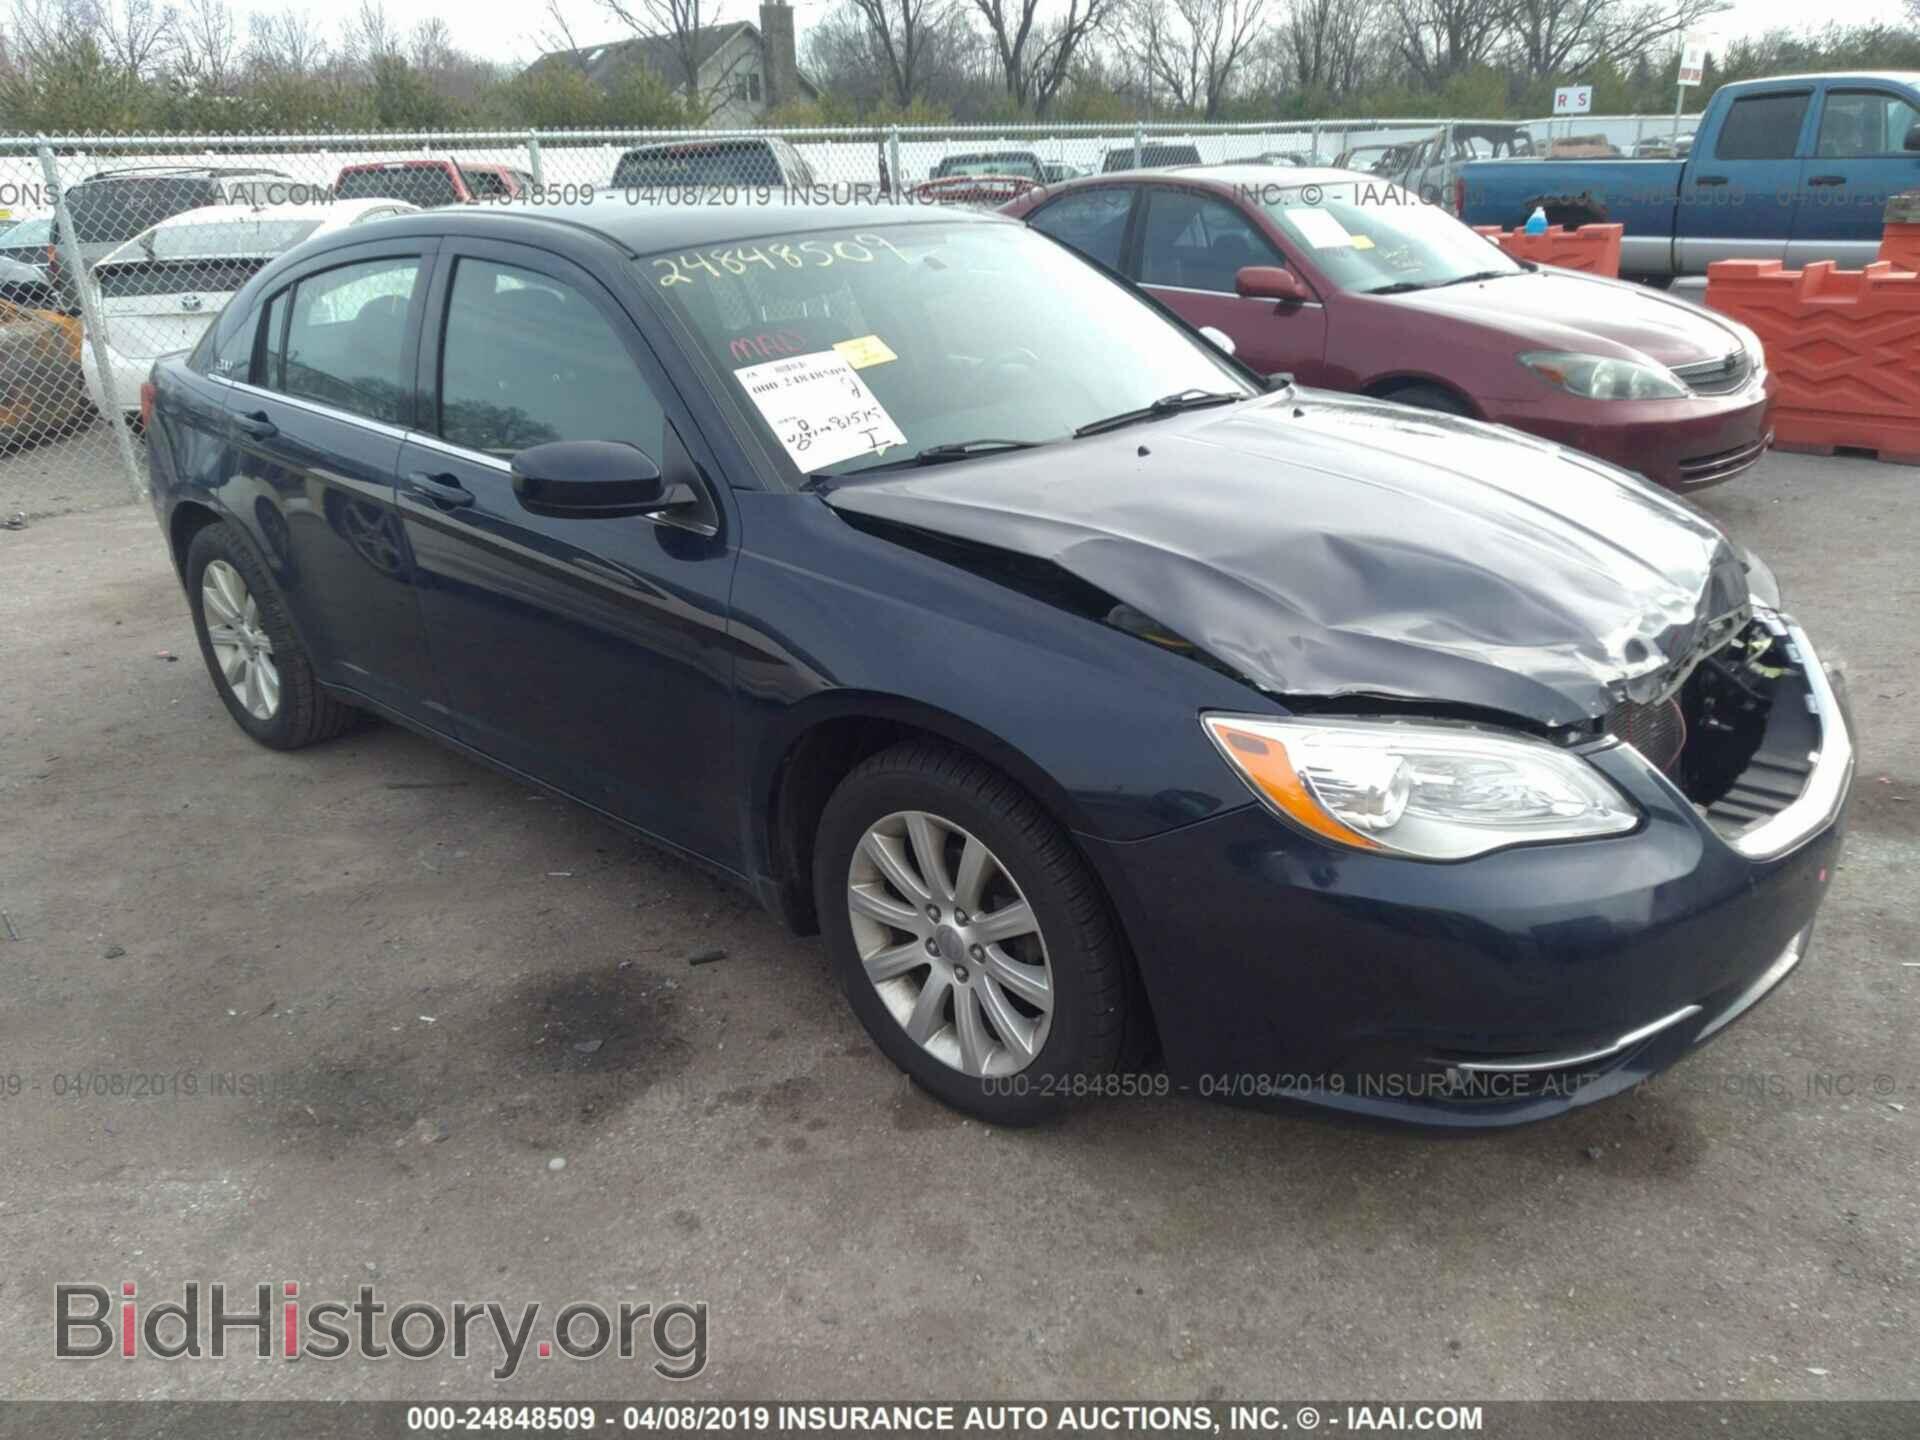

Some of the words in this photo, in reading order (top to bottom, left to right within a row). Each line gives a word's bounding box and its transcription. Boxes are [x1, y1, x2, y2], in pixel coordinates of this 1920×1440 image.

[1557, 94, 1568, 108] R
[1577, 93, 1587, 107] S
[652, 232, 914, 286] 24848509
